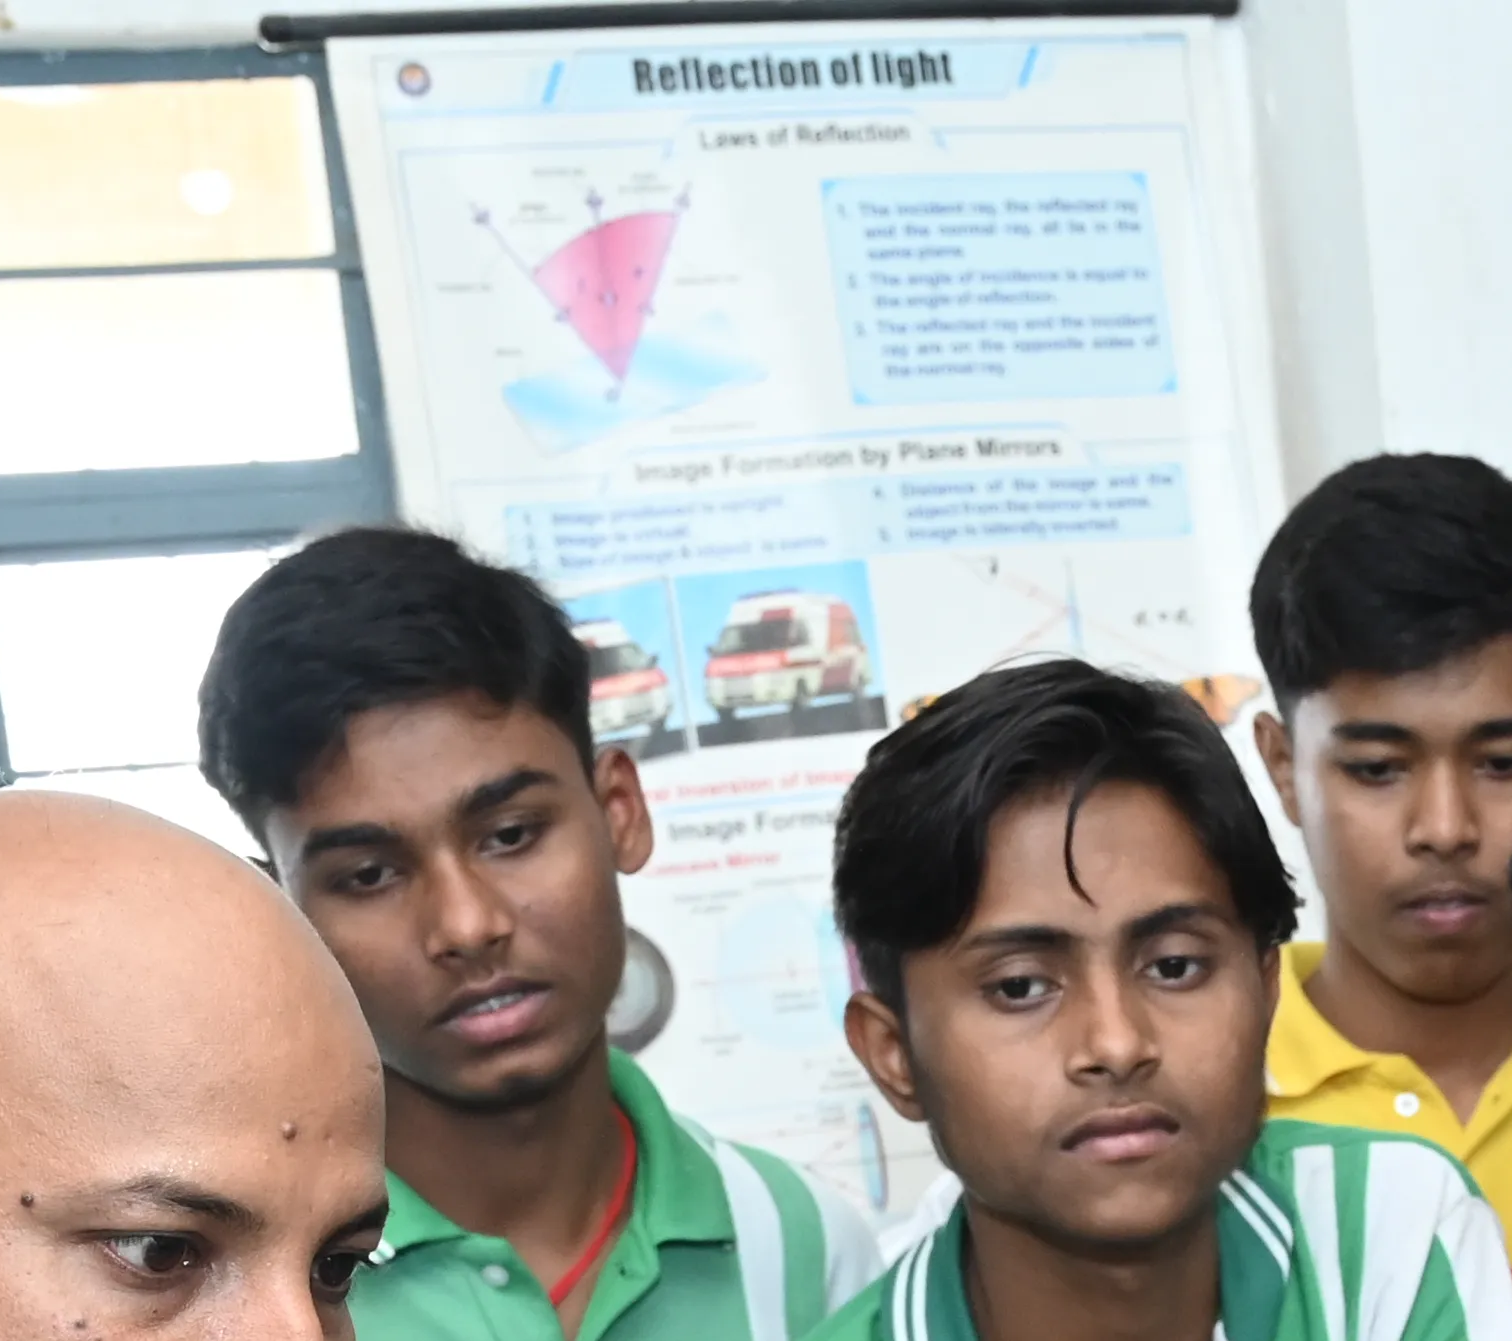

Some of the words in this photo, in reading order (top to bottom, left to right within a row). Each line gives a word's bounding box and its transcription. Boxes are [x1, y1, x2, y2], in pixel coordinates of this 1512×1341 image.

[633, 54, 821, 93] Reflection
[830, 52, 864, 86] of
[871, 50, 955, 88] light
[699, 130, 759, 151] Laws
[766, 127, 789, 147] of
[795, 123, 912, 145] Reflection
[634, 461, 713, 484] Image
[720, 447, 853, 477] Formation
[859, 443, 891, 470] by
[898, 440, 968, 461] Plane
[974, 437, 1063, 458] Mirrors
[668, 820, 747, 844] Image
[754, 810, 834, 833] Forma
